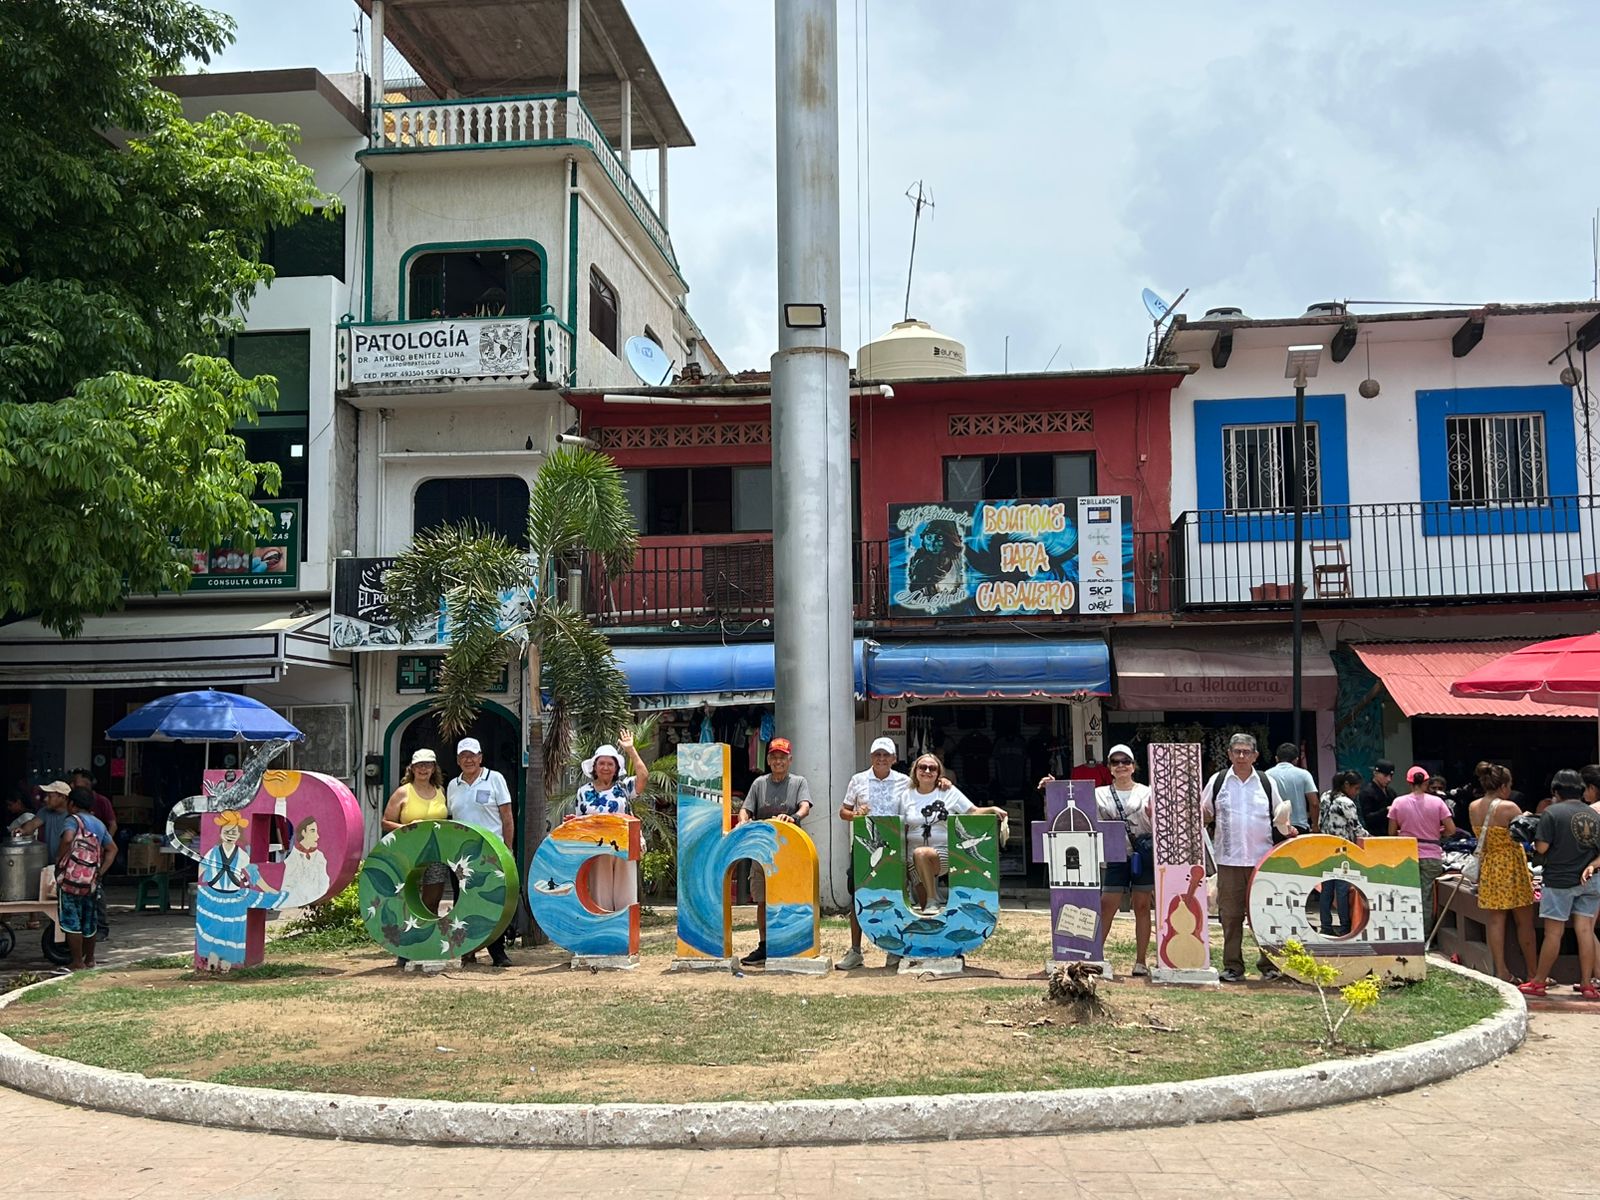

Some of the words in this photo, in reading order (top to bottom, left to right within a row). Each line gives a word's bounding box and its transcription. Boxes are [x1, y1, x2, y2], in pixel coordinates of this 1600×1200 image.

[355, 325, 469, 352] PATOLOGÍA
[374, 355, 405, 363] ARTURO
[408, 351, 441, 360] BENÍTEZ
[444, 351, 465, 359] LUNA
[1086, 498, 1119, 506] BILLABONG
[984, 503, 1065, 535] BOUTIQUE
[1001, 542, 1050, 576] PARA
[207, 578, 250, 586] CONSULTA
[252, 577, 283, 585] GRATIS
[357, 590, 371, 608] EL
[977, 581, 1074, 613] CABALLERO
[1089, 586, 1113, 596] SKP
[1172, 677, 1193, 693] La
